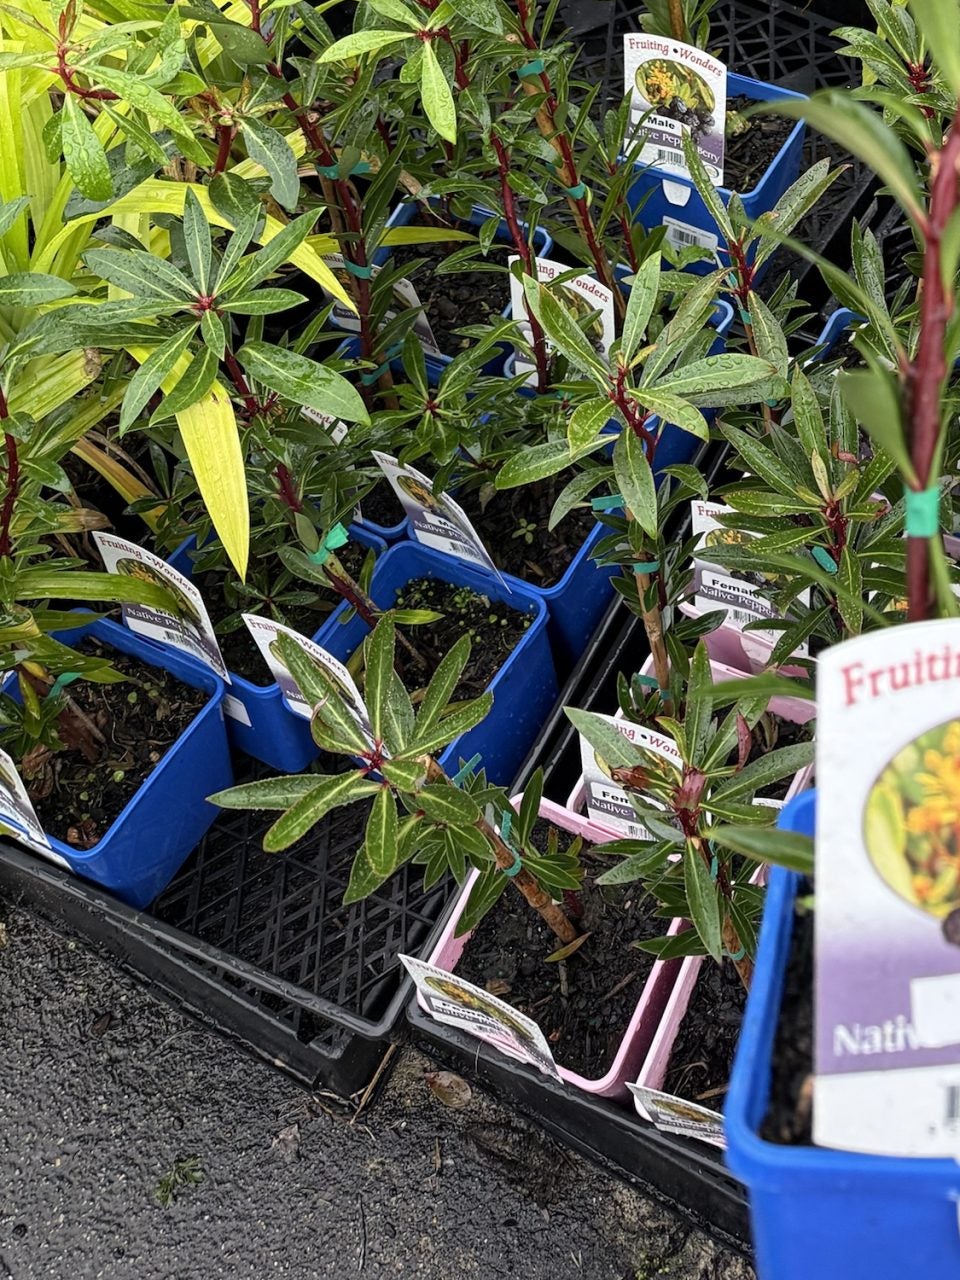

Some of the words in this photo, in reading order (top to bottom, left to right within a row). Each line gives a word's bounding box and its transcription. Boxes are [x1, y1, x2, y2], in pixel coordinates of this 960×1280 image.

[628, 38, 669, 56] Fruiting
[680, 47, 723, 77] Wonders
[647, 116, 676, 130] Male
[98, 536, 143, 561] Fruiting
[151, 557, 198, 597] Wonders
[699, 585, 735, 601] Native
[738, 596, 777, 619] Pepper
[127, 608, 162, 623] Native
[591, 798, 633, 816] Native
